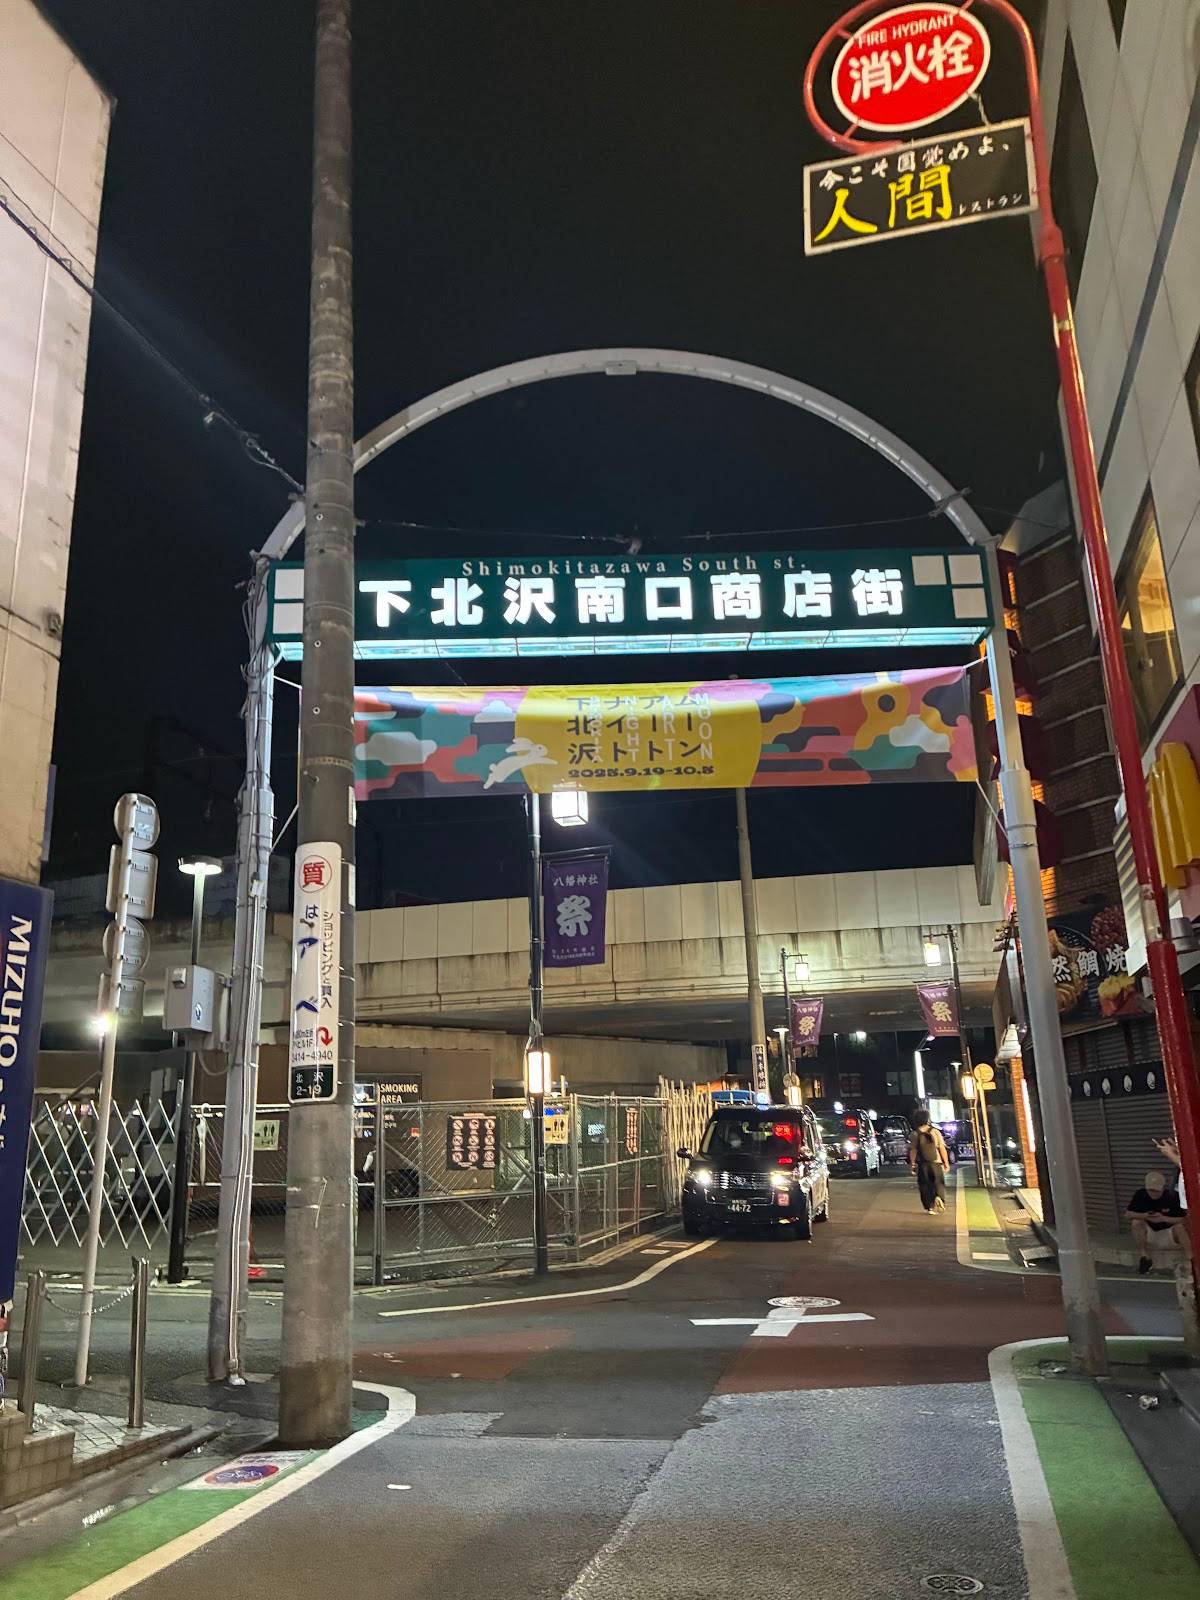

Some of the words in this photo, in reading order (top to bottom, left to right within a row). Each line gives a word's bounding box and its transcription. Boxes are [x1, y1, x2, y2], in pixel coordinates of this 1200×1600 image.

[858, 28, 887, 48] FIRE
[892, 14, 955, 40] HYDRANT
[848, 30, 975, 103] 消火栓
[815, 164, 953, 242] 人間
[958, 193, 1022, 215] レストラン
[462, 560, 666, 576] Shimokitazawa
[683, 556, 757, 571] South
[773, 555, 806, 570] st.
[358, 569, 904, 628] 下北沢南口商店街
[566, 697, 598, 764] 下北沢
[604, 696, 627, 762] ナイト
[625, 695, 640, 762] NIGHT
[639, 696, 664, 761] アート
[663, 694, 675, 761] ART
[675, 696, 702, 758] ムーン
[696, 692, 713, 760] MOON
[303, 861, 325, 888] 質
[556, 895, 592, 937] 祭
[0, 915, 33, 1068] MIZUHO
[380, 1083, 418, 1093] SMOKING
[381, 1094, 403, 1104] AREA
